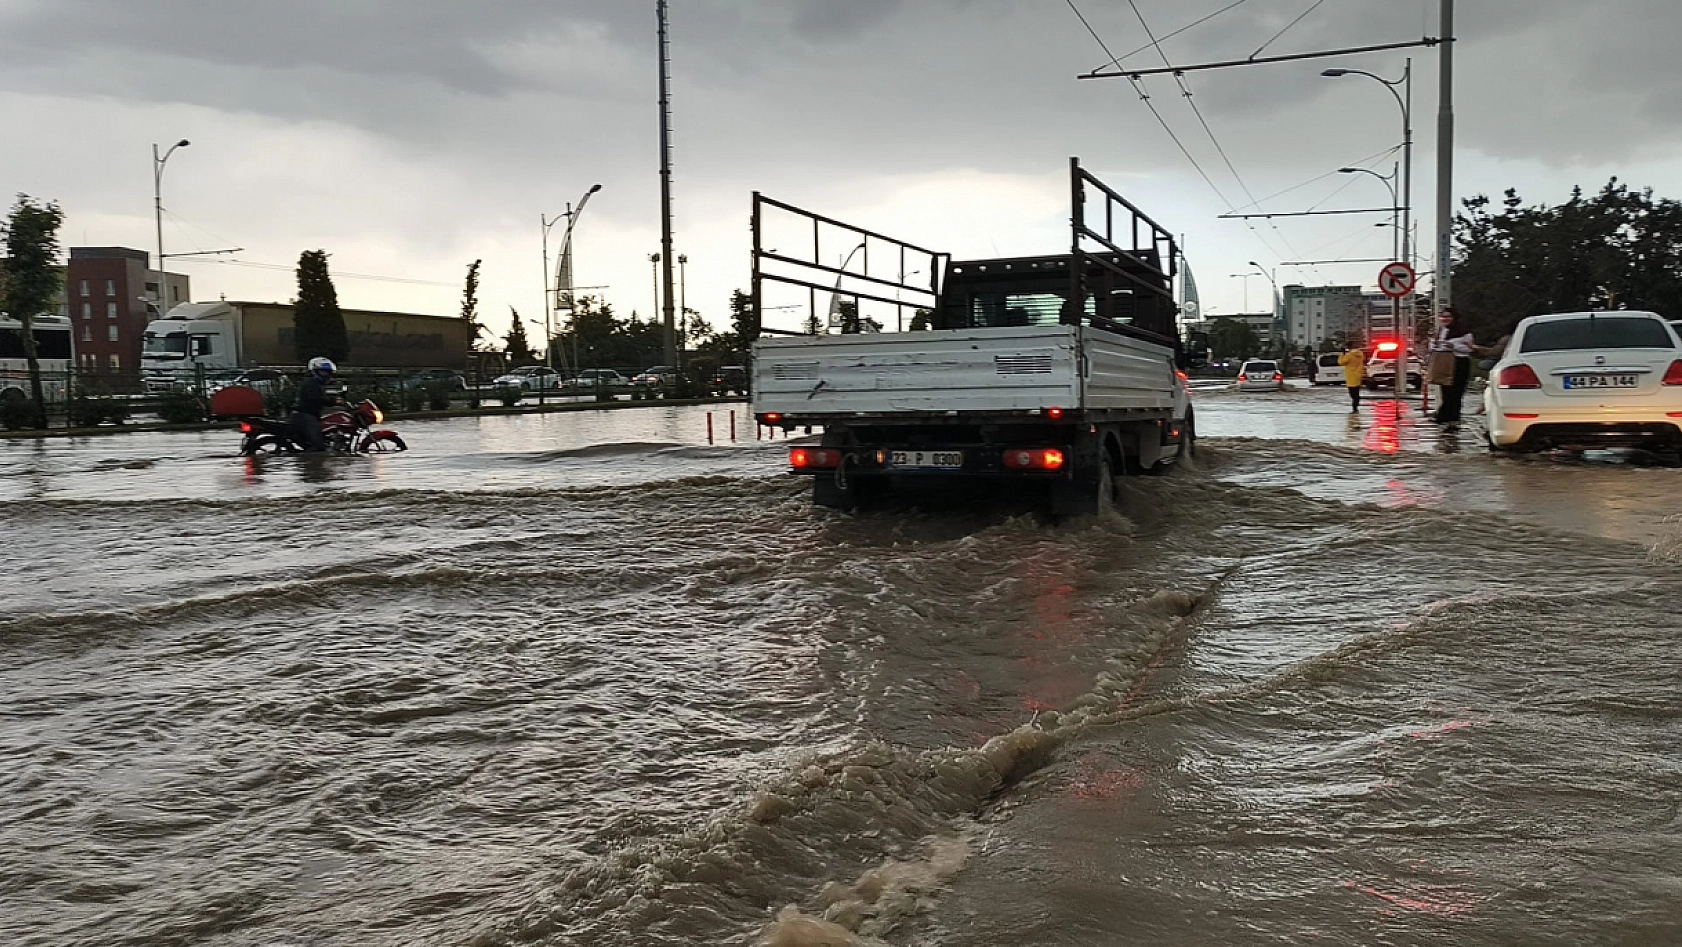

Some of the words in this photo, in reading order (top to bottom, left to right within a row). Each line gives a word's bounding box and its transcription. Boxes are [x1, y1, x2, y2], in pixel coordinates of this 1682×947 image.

[1572, 376, 1585, 386] 44
[1590, 376, 1608, 386] PA
[1613, 376, 1635, 386] 144
[916, 452, 924, 465] P
